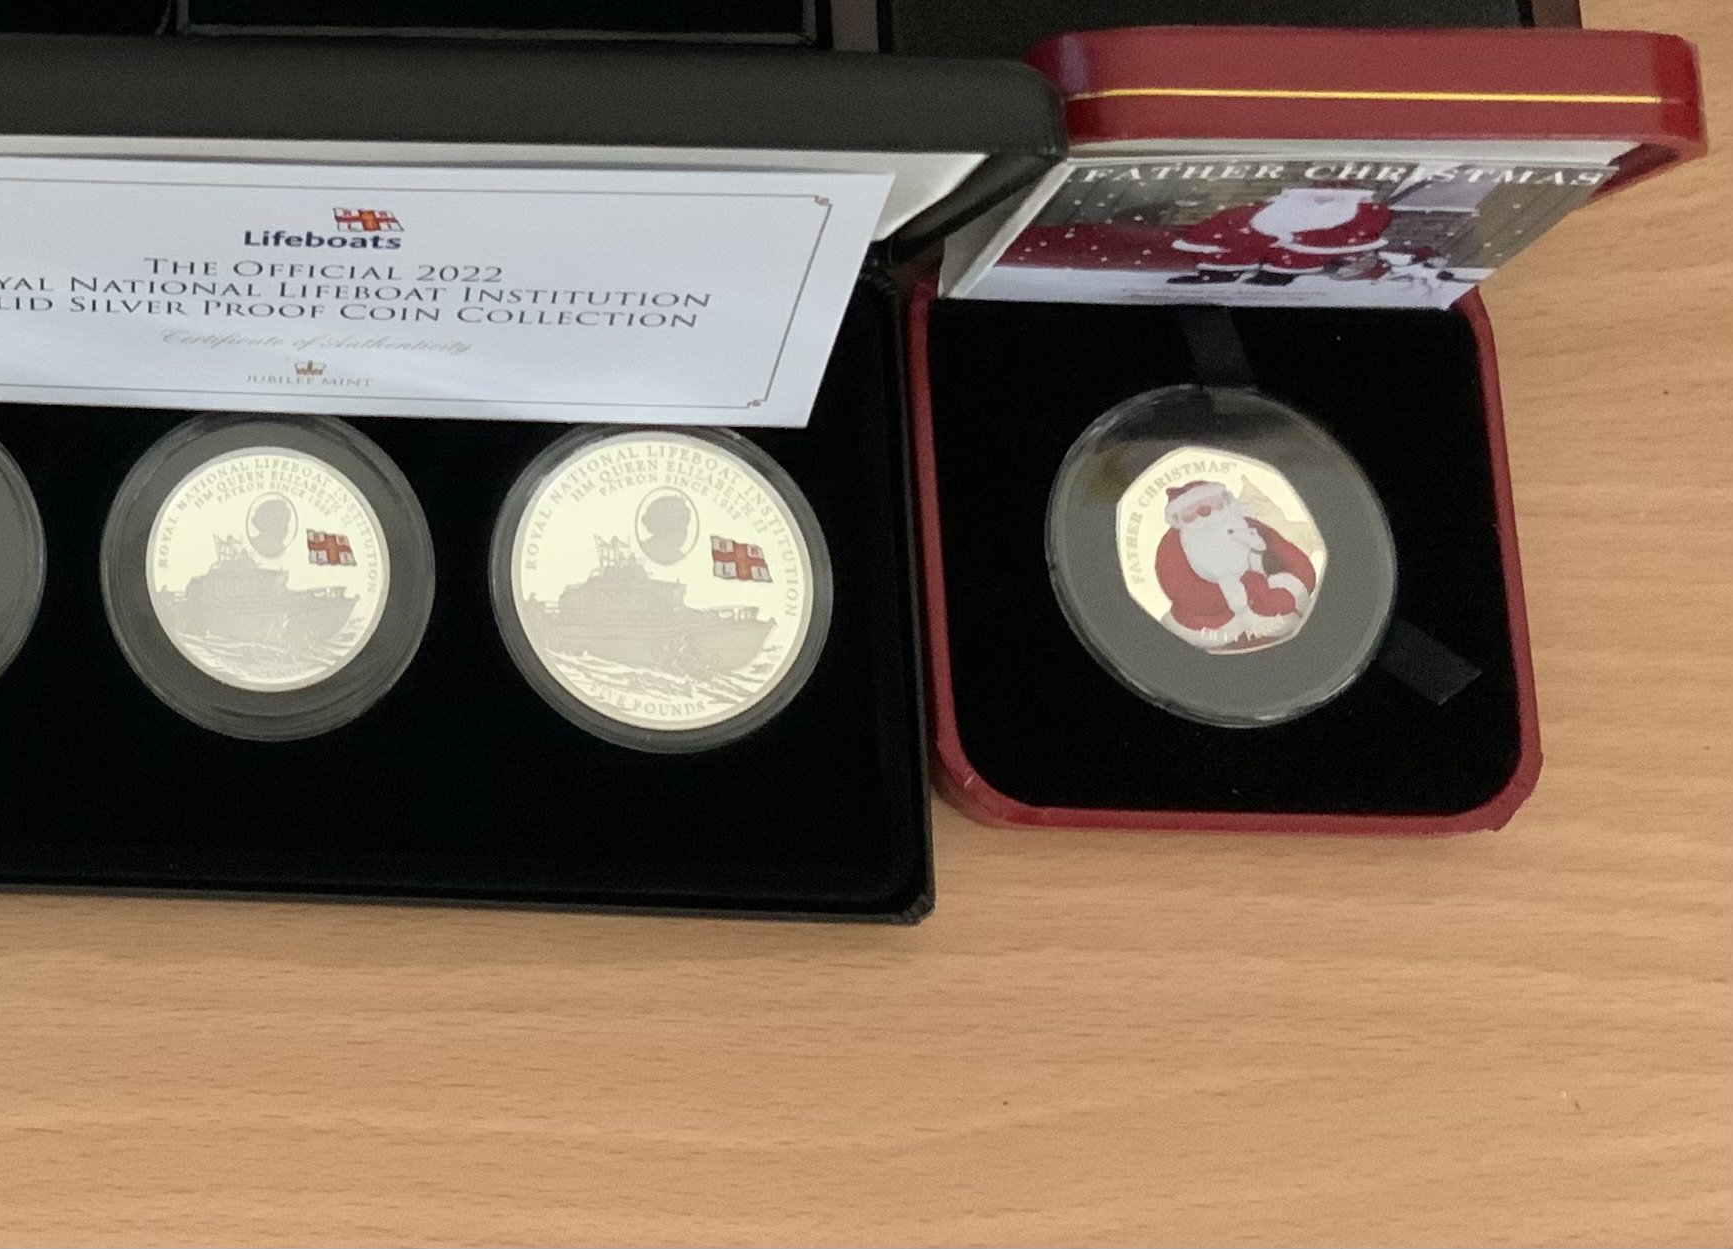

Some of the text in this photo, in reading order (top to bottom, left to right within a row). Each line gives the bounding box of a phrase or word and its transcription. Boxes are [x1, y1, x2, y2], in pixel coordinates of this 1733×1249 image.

[1081, 162, 1609, 187] FATHER CHRISTMAS
[244, 230, 402, 250] Lifeboats
[143, 257, 503, 283] THE OFFICIAL 2022
[69, 276, 263, 298] NATIONAL
[278, 281, 448, 303] LIFEBOAT
[463, 286, 713, 309] INSTITUTION
[69, 296, 188, 317] SILVER
[203, 299, 325, 320] PROOF
[339, 302, 440, 322] COIN
[456, 305, 700, 329] COLLECTION
[161, 329, 473, 356] Certificate of Authenticity
[321, 377, 374, 387] MINT
[176, 460, 249, 515] NATIONAL
[254, 458, 332, 489] LIFEBOAT
[216, 471, 265, 492] QUEEN
[598, 473, 658, 497] PATRON
[664, 473, 709, 497] SINCE
[599, 460, 659, 482] QUEEN
[666, 460, 757, 516] ELIZABETH
[526, 445, 799, 618] ROYAL NATIONAL LIFEBOAT INSTITUTION
[1127, 512, 1145, 586] FATHER
[633, 700, 706, 716] POUNDS
